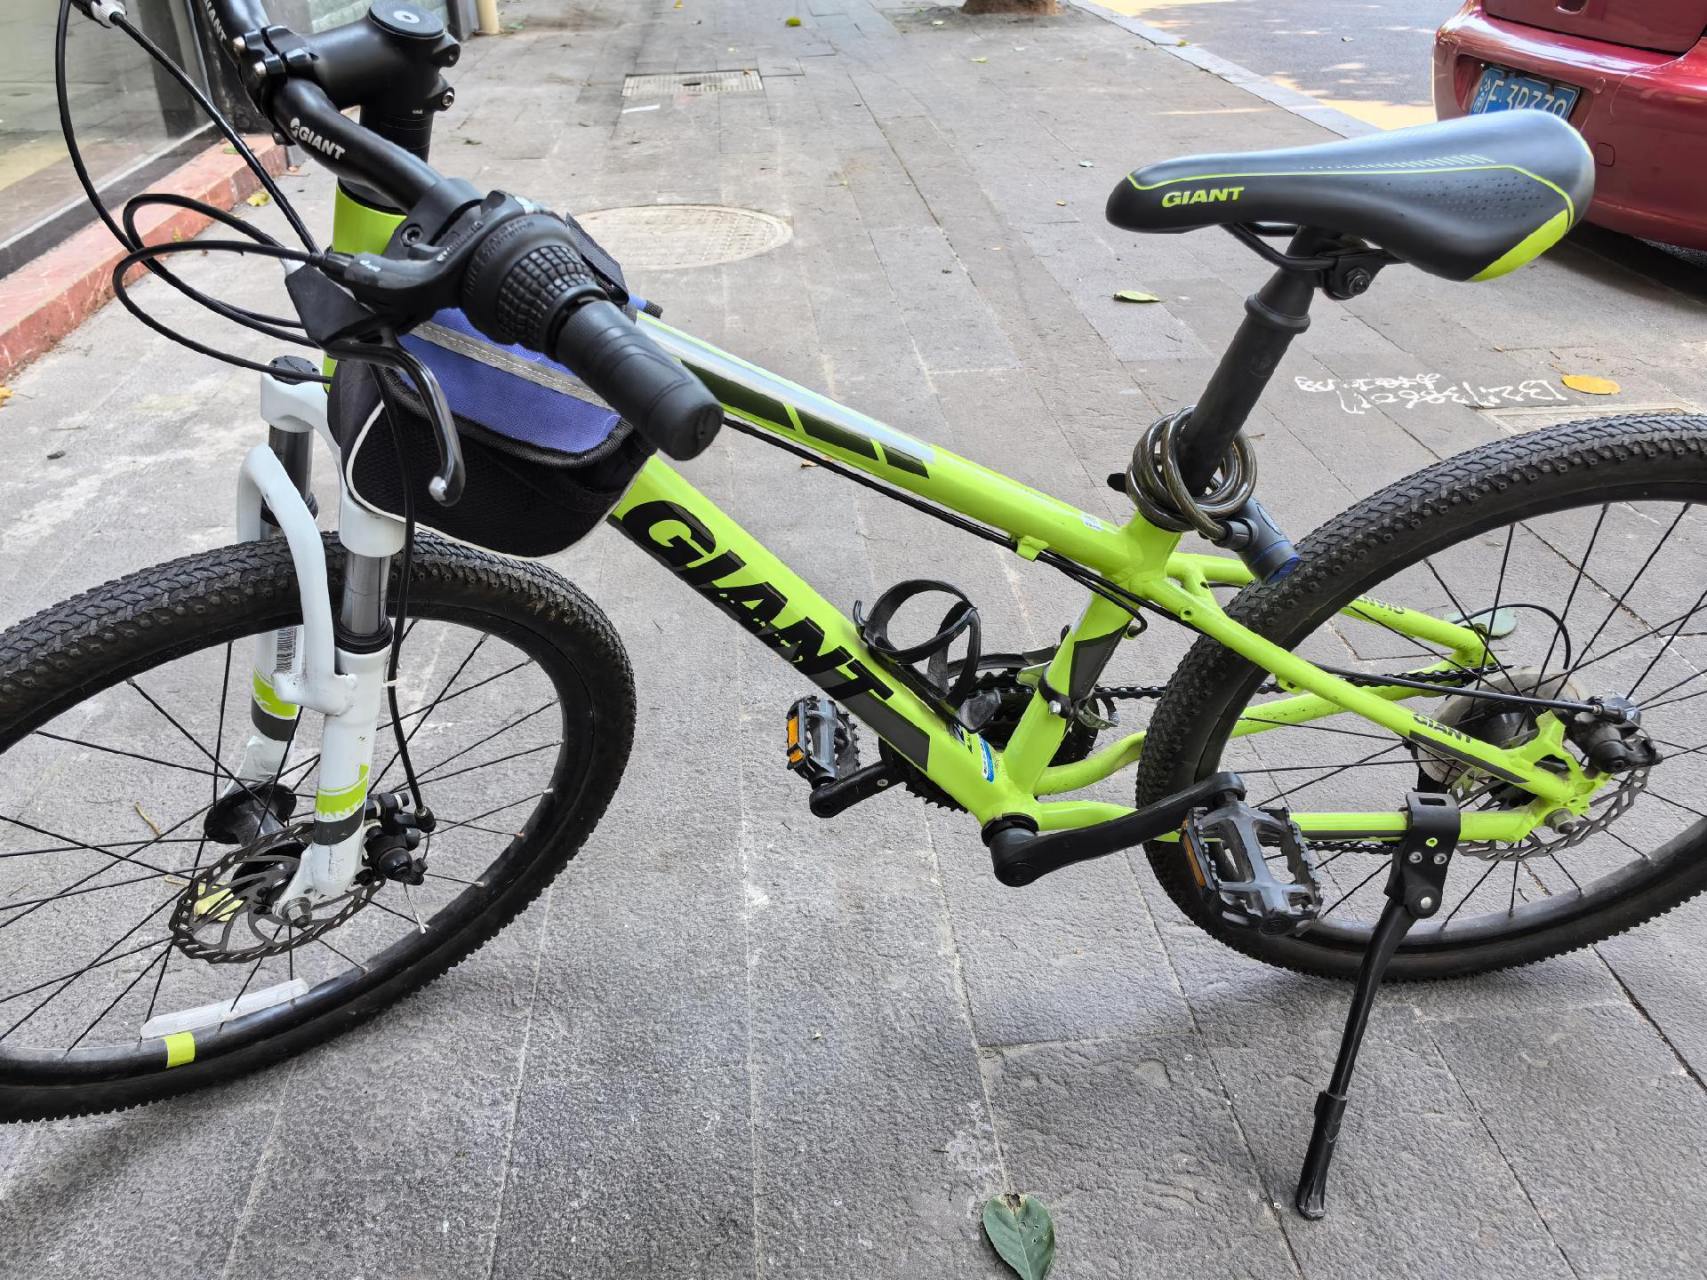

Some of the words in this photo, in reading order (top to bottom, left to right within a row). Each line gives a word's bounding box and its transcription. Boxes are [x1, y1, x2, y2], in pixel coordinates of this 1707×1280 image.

[299, 126, 345, 160] GIANT
[1162, 187, 1244, 207] GIANT
[621, 500, 894, 701] GIANT
